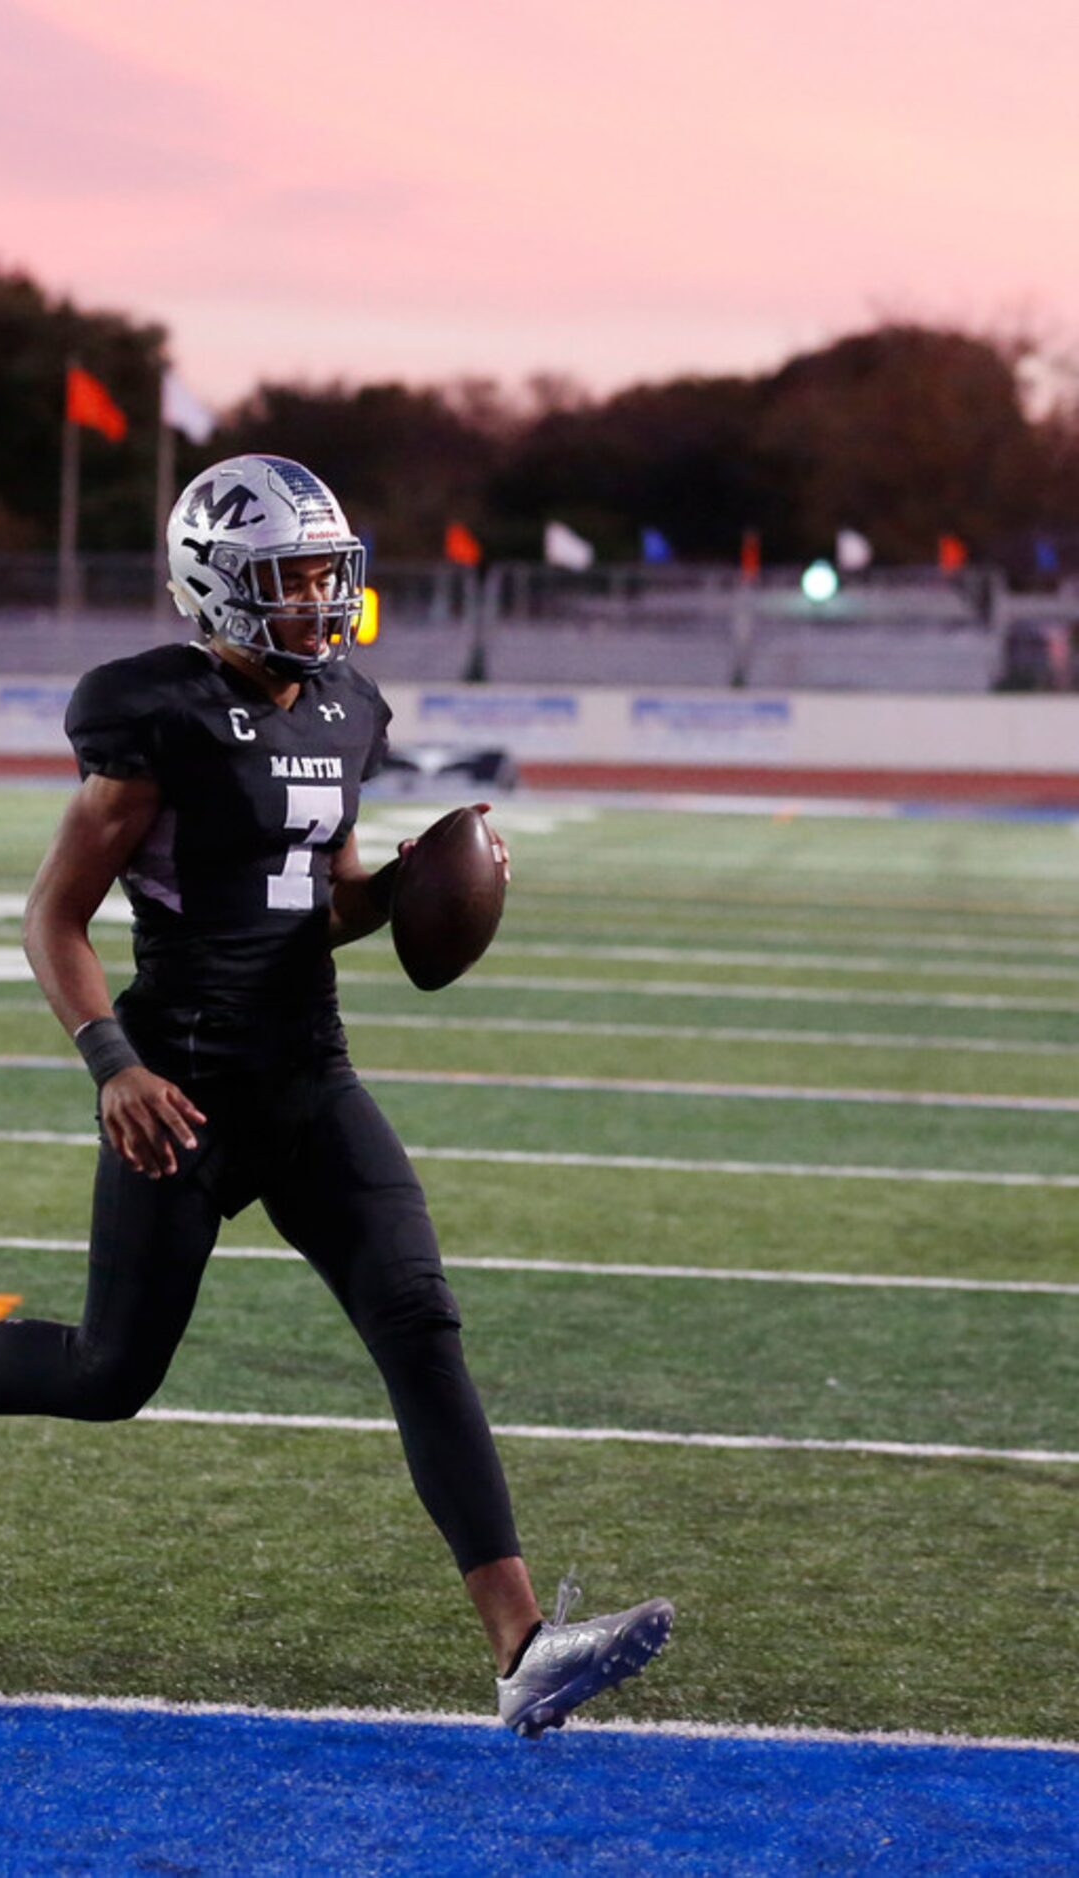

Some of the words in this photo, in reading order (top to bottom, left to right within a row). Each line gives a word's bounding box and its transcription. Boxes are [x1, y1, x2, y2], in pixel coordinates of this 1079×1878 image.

[183, 481, 258, 530] M
[229, 708, 257, 741] C
[270, 756, 343, 778] MARTIN
[267, 785, 344, 909] 7
